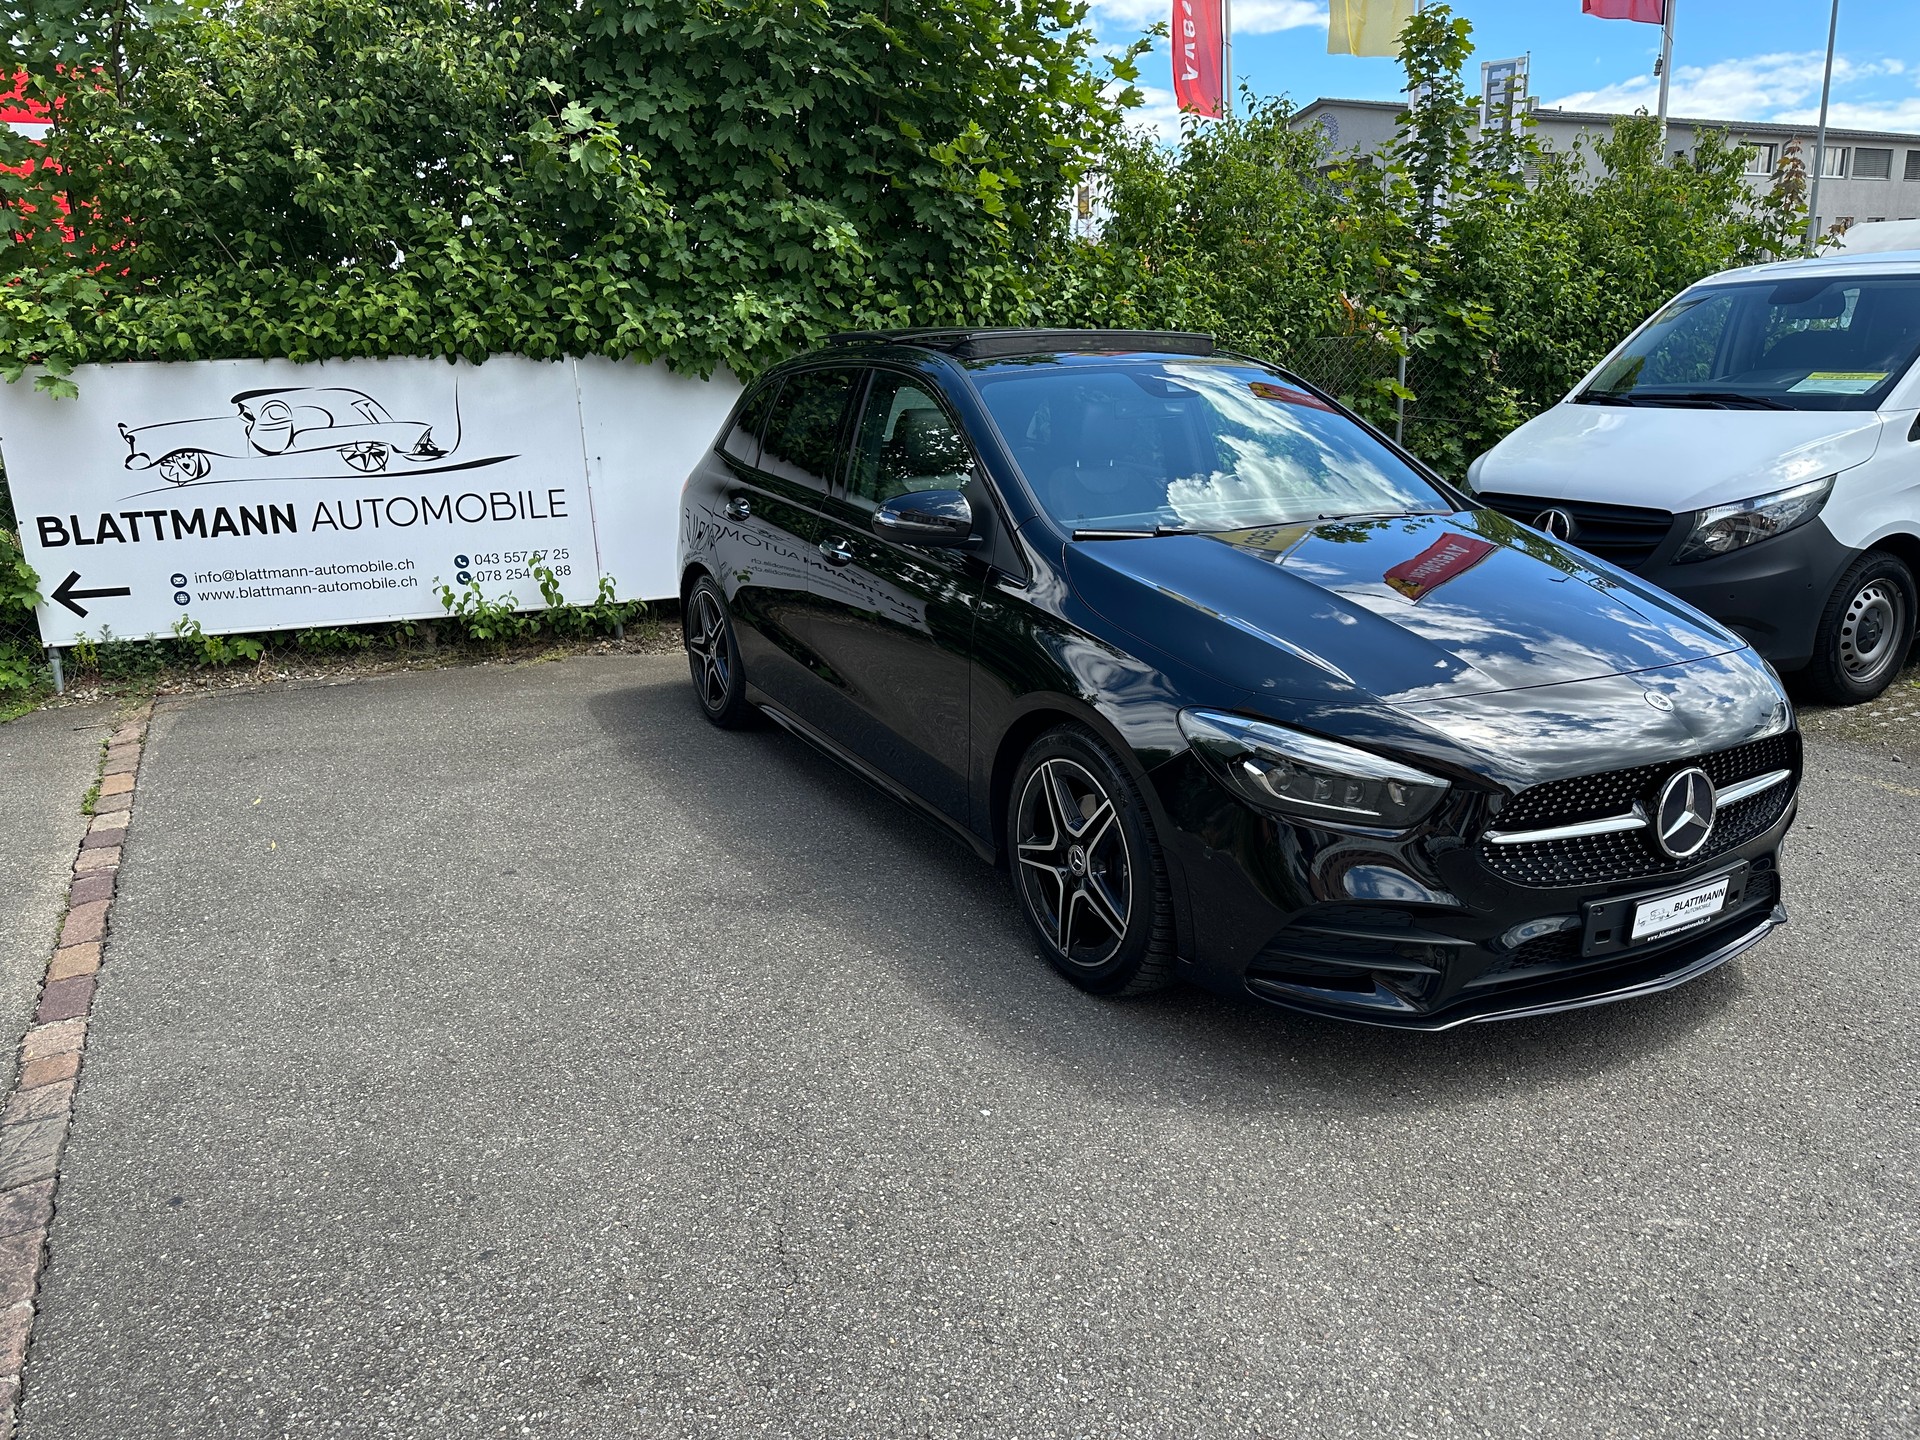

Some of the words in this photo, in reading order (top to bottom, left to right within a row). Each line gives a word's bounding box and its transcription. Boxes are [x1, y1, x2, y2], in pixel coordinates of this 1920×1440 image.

[36, 503, 298, 548] BLATTMANN
[311, 488, 568, 532] AUTOMOBILE
[474, 552, 500, 566] 043
[504, 551, 528, 563] 557
[553, 548, 570, 560] 25
[194, 558, 416, 584] info@blattmann-automobile.ch
[476, 569, 502, 582] 078
[505, 567, 531, 580] 254
[555, 564, 572, 577] 88
[197, 575, 419, 602] www.blattmann-automobile.ch
[1673, 887, 1726, 912] BLATTMANN
